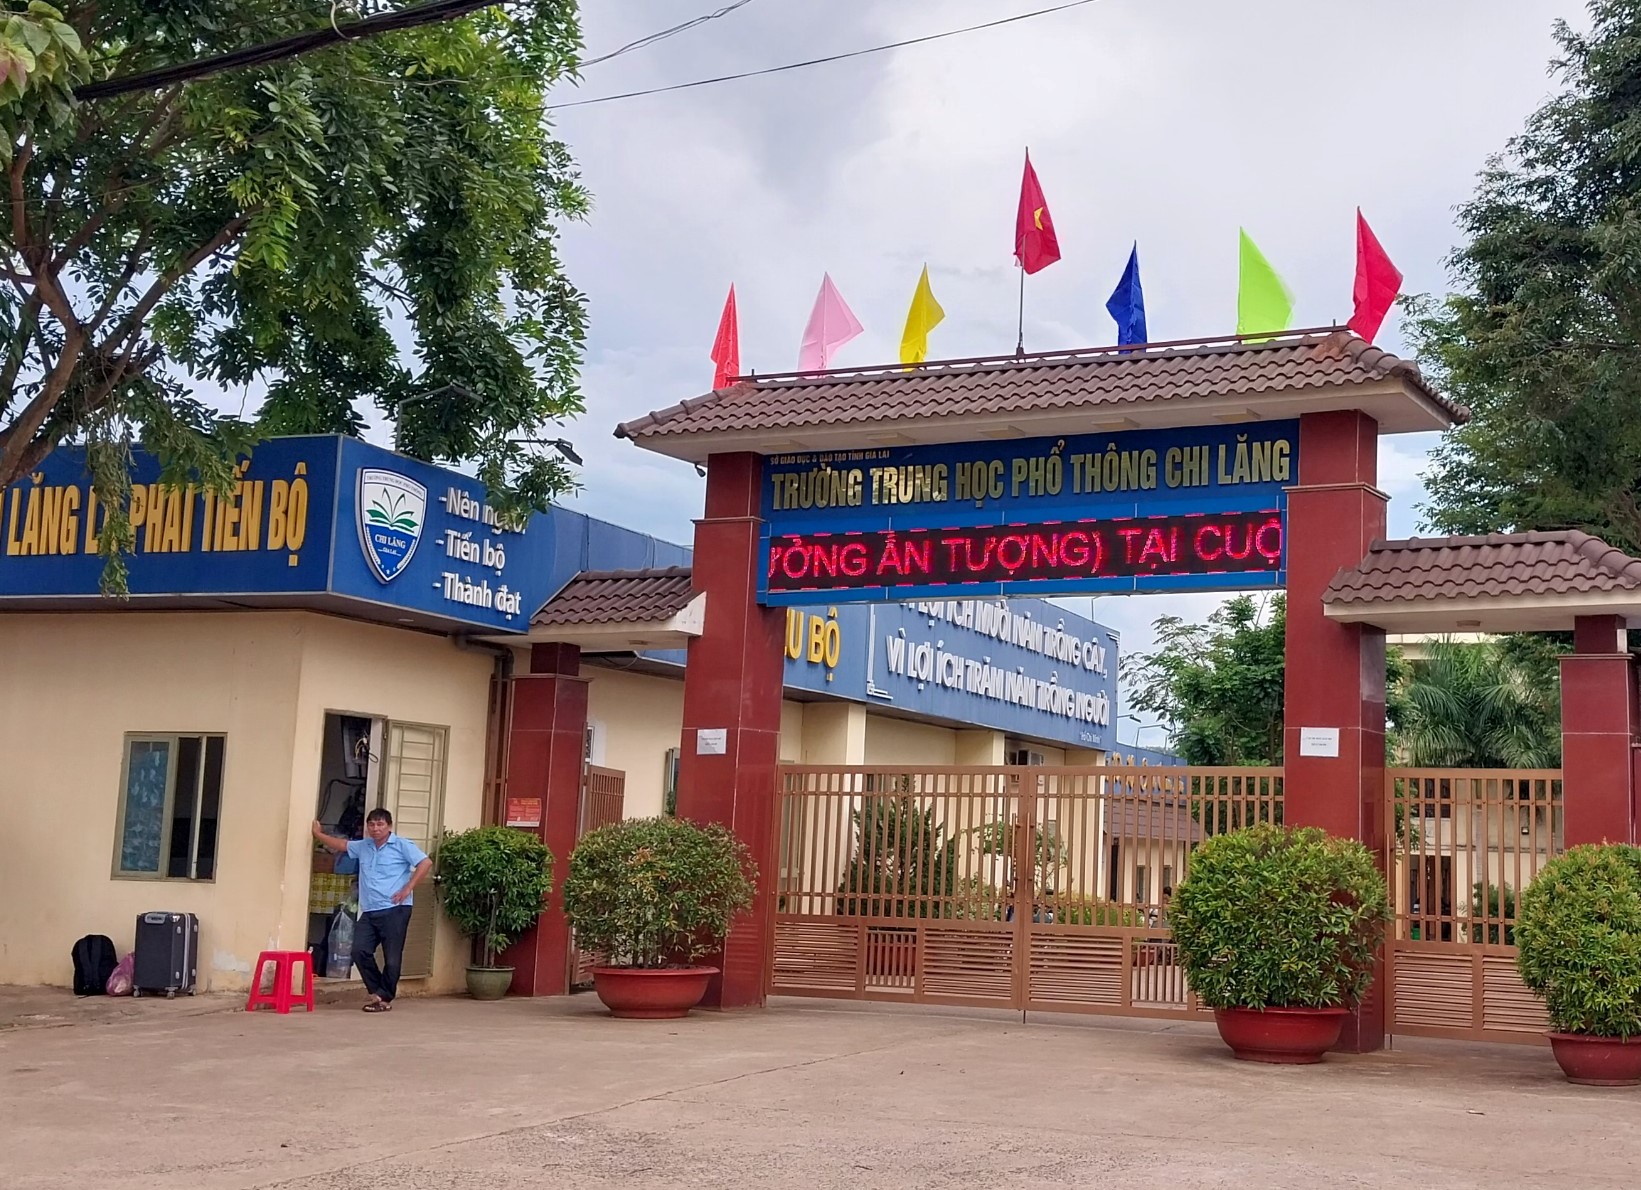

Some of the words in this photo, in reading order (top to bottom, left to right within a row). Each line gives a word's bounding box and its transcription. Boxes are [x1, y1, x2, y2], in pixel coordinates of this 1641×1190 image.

[771, 463, 863, 510] TRƯỜNG
[869, 463, 948, 504] TRUNG
[955, 461, 1004, 508] HỌC
[1011, 439, 1066, 497] PHỔ
[1070, 442, 1157, 494] THÔNG
[1164, 445, 1211, 487] CHI
[1217, 433, 1291, 485] LĂNG
[6, 471, 82, 556] LĂNG
[267, 461, 309, 567] BỘ
[374, 533, 388, 545] CHI
[482, 538, 507, 577] bộ
[940, 533, 1104, 577] TƯỢNG)
[1117, 528, 1179, 570] TẠI
[494, 584, 522, 621] đạt
[807, 605, 842, 682] BỘ
[1012, 610, 1043, 653] NĂM
[1043, 617, 1082, 666] TRỒNG
[886, 627, 907, 675] VÌ
[907, 641, 934, 691] LỢI
[935, 639, 965, 690] ÍCH
[965, 655, 1004, 700] TRĂM
[1004, 665, 1036, 708] NĂM
[1036, 670, 1076, 717] TRỒNG
